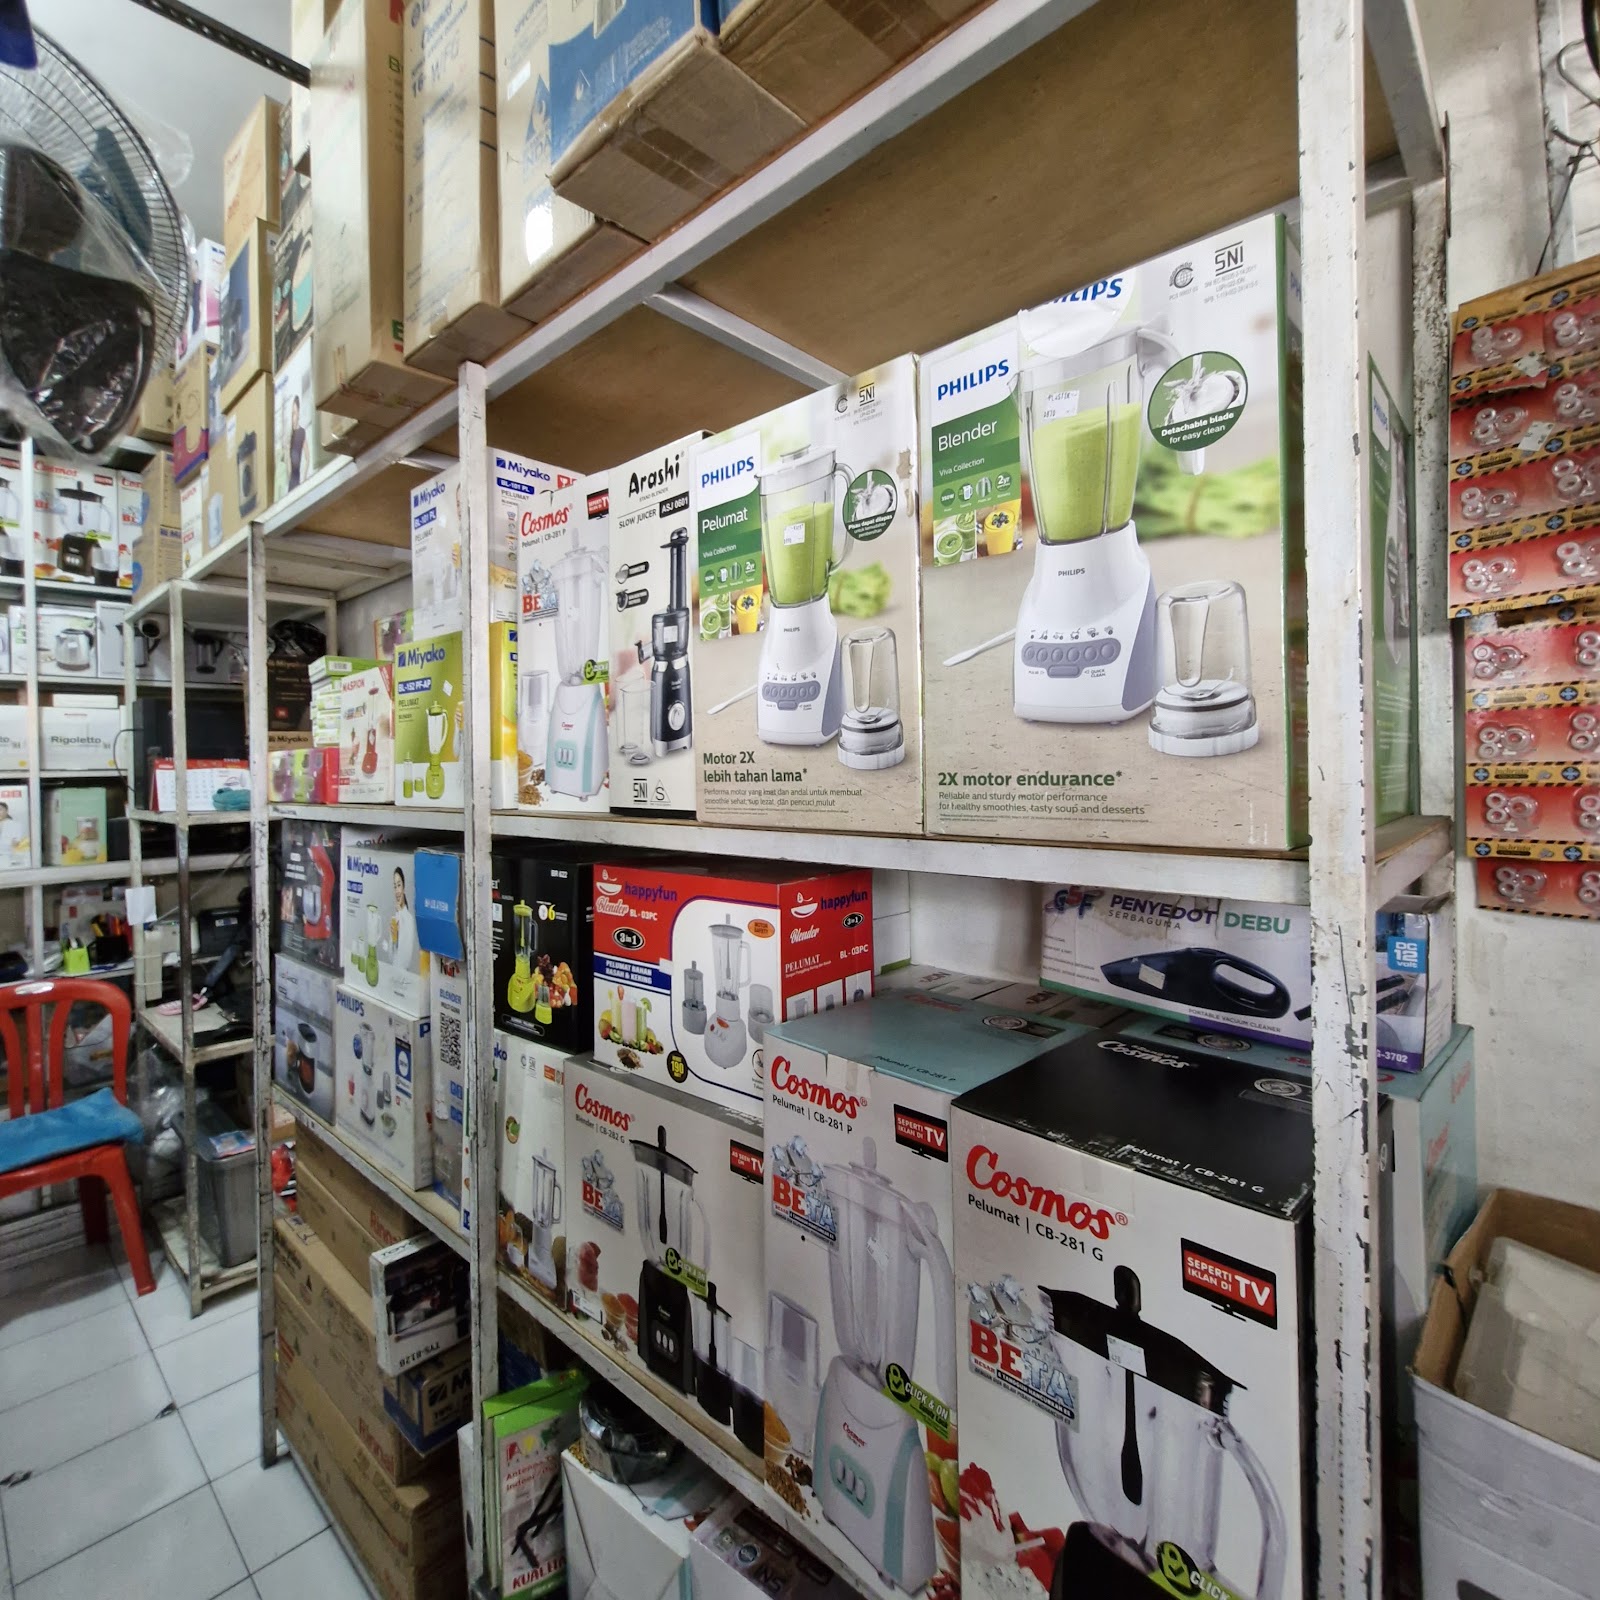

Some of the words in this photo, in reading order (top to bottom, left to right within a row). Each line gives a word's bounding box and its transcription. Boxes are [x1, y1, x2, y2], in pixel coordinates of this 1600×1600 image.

[1215, 246, 1243, 272] SNI
[937, 360, 1009, 401] PHILIPS
[859, 386, 875, 403] SNI
[1161, 420, 1208, 437] Detachable
[1209, 412, 1234, 424] blade
[1169, 436, 1181, 444] for
[1182, 431, 1201, 441] easy
[1203, 425, 1226, 436] clean
[938, 419, 998, 452] Blender
[508, 460, 551, 482] Miyako
[629, 454, 680, 497] Arashi
[701, 456, 755, 489] PHILIPS
[939, 468, 953, 477] Viva
[953, 456, 985, 472] Collection
[418, 482, 446, 506] Miyako
[618, 516, 636, 529] SLOW
[637, 508, 657, 524] JUICER
[661, 501, 674, 515] ASJ
[521, 506, 569, 537] Cosmos
[702, 507, 748, 534] Pelumat
[522, 537, 540, 548] Pelumat
[1058, 568, 1085, 577] PHILIPS
[408, 643, 445, 669] Miyako
[51, 735, 101, 745] Rigoletto
[703, 752, 737, 765] Motor
[739, 751, 755, 764] 2X
[703, 770, 732, 783] lebih
[734, 769, 768, 783] tahan
[938, 771, 958, 786] 2X
[962, 772, 1012, 787] motor
[633, 783, 648, 797] SNI
[703, 788, 730, 796] Performa
[748, 789, 763, 797] yang
[777, 788, 789, 796] dan
[790, 788, 808, 796] andal
[809, 788, 828, 796] untuk
[829, 788, 862, 796] membuat
[938, 791, 970, 800] Reliable
[971, 792, 987, 801] and
[989, 792, 1016, 802] sturdy
[1017, 793, 1045, 802] motor
[1046, 793, 1108, 803] performance
[777, 798, 789, 806] dan
[790, 799, 815, 807] pencuci
[816, 799, 836, 807] mulut
[938, 802, 950, 811] for
[951, 802, 981, 812] healthy
[982, 803, 1029, 812] smoothies,
[1030, 804, 1053, 814] tasty
[1055, 806, 1079, 815] soup
[1080, 804, 1100, 814] and
[1101, 805, 1146, 815] desserts
[352, 856, 379, 877] Miyako
[625, 881, 677, 902] happyfun
[821, 889, 868, 911] happyfun
[548, 904, 556, 920] 6
[596, 896, 629, 916] Blender
[629, 909, 637, 918] BL
[1109, 894, 1217, 925] PENYEDOT
[1223, 911, 1291, 934] DEBU
[1108, 909, 1181, 930] SERBAGUNA
[790, 925, 820, 944] Blender
[840, 950, 847, 959] BL
[851, 944, 869, 956] 03PC
[1394, 949, 1418, 962] 12
[1395, 942, 1418, 951] DC
[606, 960, 631, 971] PELUMAT
[785, 954, 820, 973] PELUMAT
[1397, 960, 1418, 968] volt
[337, 992, 364, 1017] PHILIPS
[440, 988, 461, 1005] BLENDER
[1189, 1008, 1220, 1020] PORTABLE
[1222, 1014, 1249, 1025] VACUUM
[1250, 1021, 1281, 1033] CLEANER
[1097, 1040, 1189, 1069] Cosmos
[671, 1060, 684, 1074] 190
[874, 1055, 909, 1070] Pelumat
[916, 1067, 947, 1080] CB-281
[575, 1084, 631, 1131] Cosmos
[772, 1095, 806, 1116] Pelumat
[814, 1111, 844, 1132] CB-281
[847, 1124, 853, 1134] P
[898, 1117, 924, 1132] SEPERTI
[898, 1124, 915, 1137] IKLAN
[916, 1130, 924, 1139] DI
[620, 1134, 625, 1144] G
[924, 1126, 945, 1147] TV
[1124, 1143, 1181, 1167] Pelumat
[1195, 1166, 1247, 1188] CB-281
[1251, 1184, 1265, 1194] G
[967, 1193, 1021, 1228] Pelumat
[1035, 1223, 1087, 1254] CB-281
[1092, 1247, 1104, 1262] G
[1187, 1256, 1232, 1281] SEPERTI
[1187, 1268, 1218, 1286] IKLAN
[1220, 1280, 1231, 1292] DI
[1234, 1274, 1271, 1307] TV
[905, 1381, 928, 1405] CLICK
[928, 1400, 935, 1410] &
[936, 1405, 949, 1420] ON
